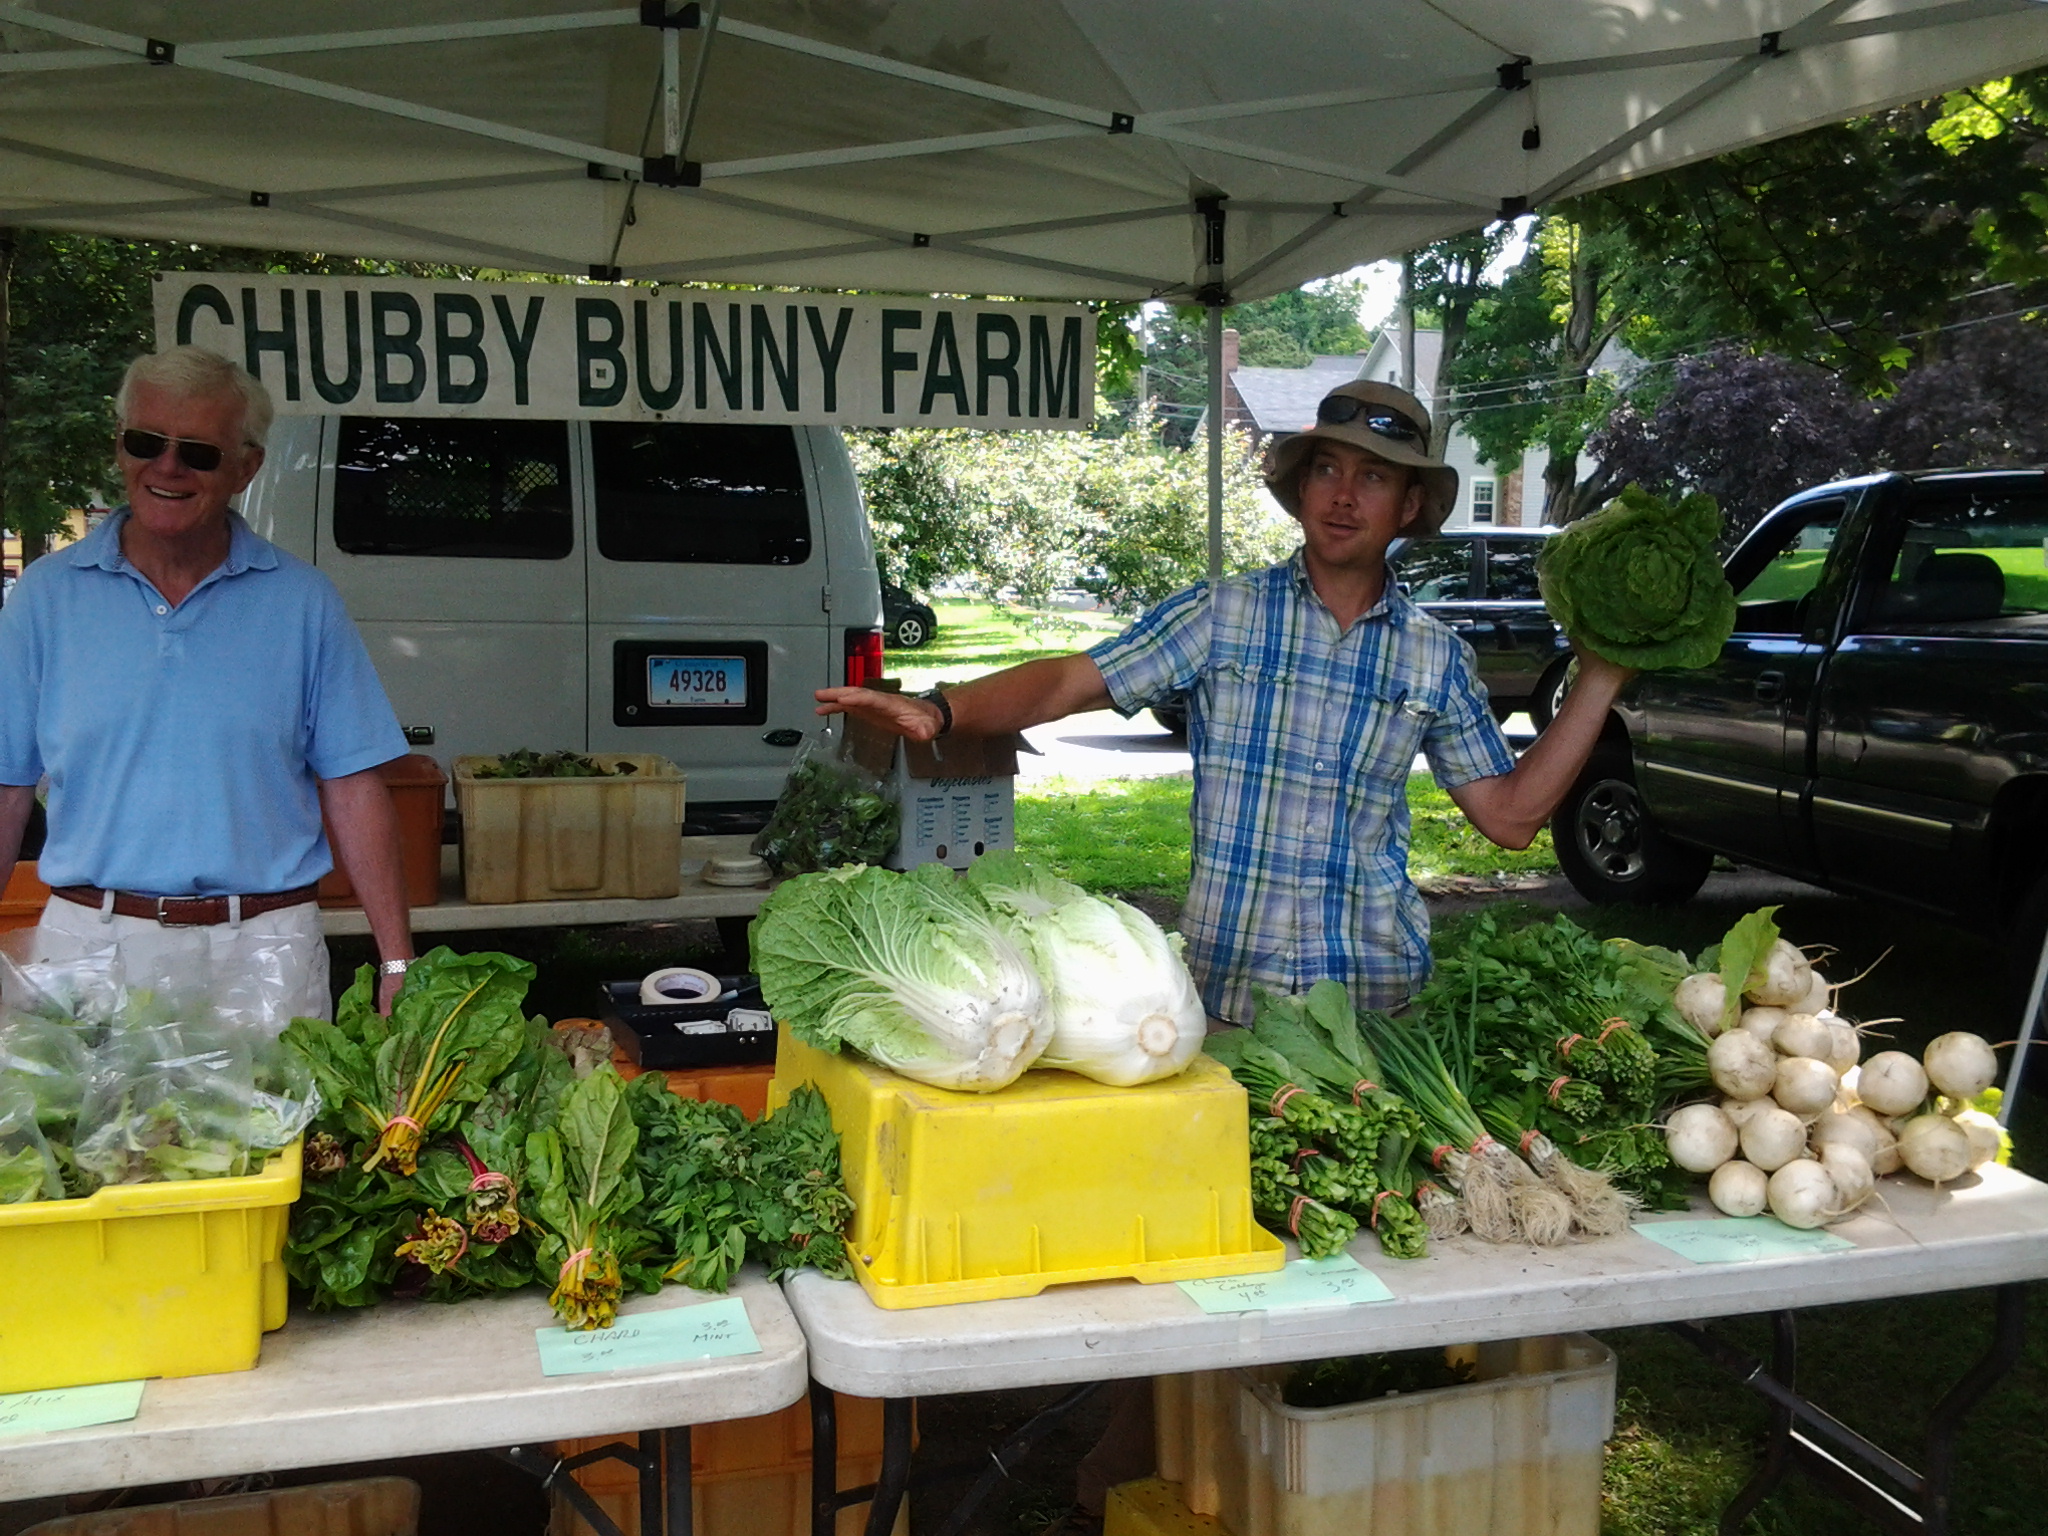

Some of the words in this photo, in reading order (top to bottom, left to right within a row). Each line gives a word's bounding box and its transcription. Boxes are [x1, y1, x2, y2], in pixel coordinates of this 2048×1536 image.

[177, 284, 544, 406] CHUBBY
[575, 298, 854, 412] BUNNY
[881, 309, 1082, 419] FARM
[669, 669, 727, 692] 49328
[573, 1329, 641, 1346] CHARD
[692, 1331, 739, 1343] MINT
